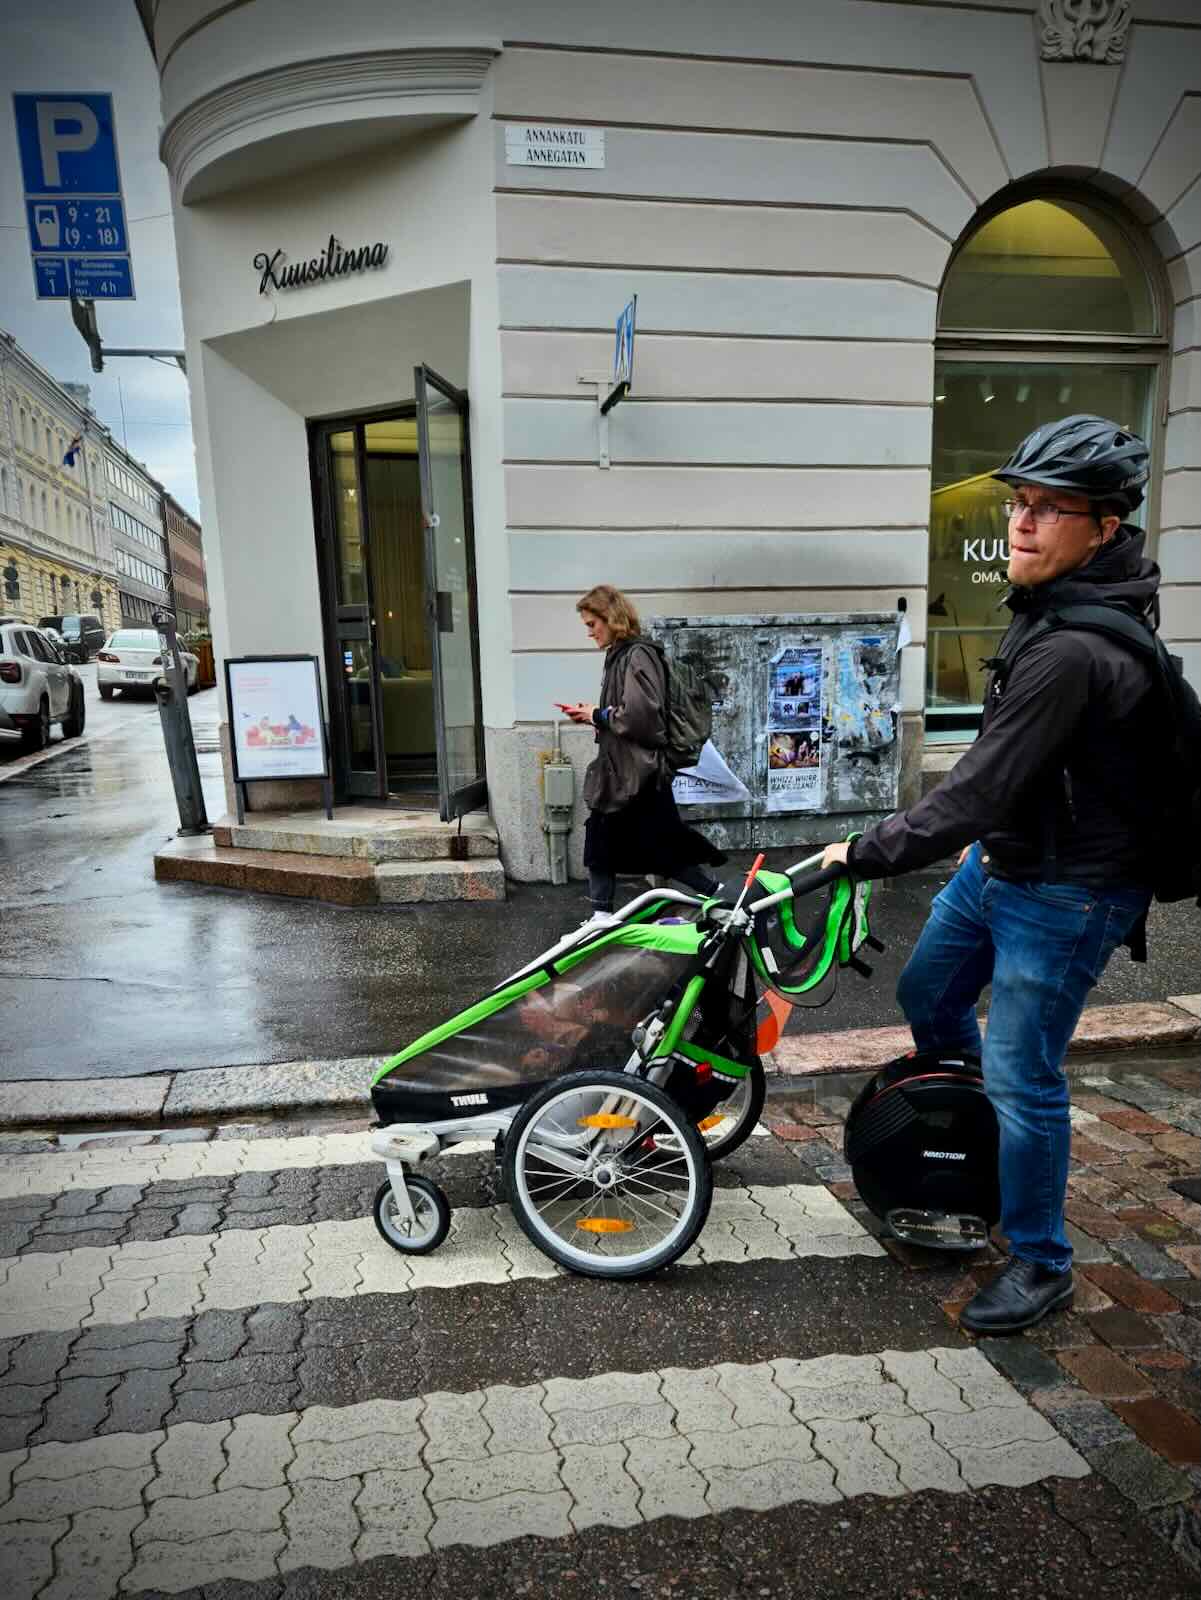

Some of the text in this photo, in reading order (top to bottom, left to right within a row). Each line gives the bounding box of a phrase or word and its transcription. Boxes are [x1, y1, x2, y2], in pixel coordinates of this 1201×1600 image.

[37, 101, 99, 187] P
[526, 128, 586, 144] ANNANKATU
[526, 148, 586, 163] ANNEGATAN
[68, 207, 78, 223] 9
[95, 207, 111, 223] 21
[65, 227, 80, 246] (9
[97, 228, 119, 246] 18)
[253, 234, 389, 295] Kuusilinna
[971, 571, 1008, 584] OMA
[450, 1093, 488, 1106] THULE
